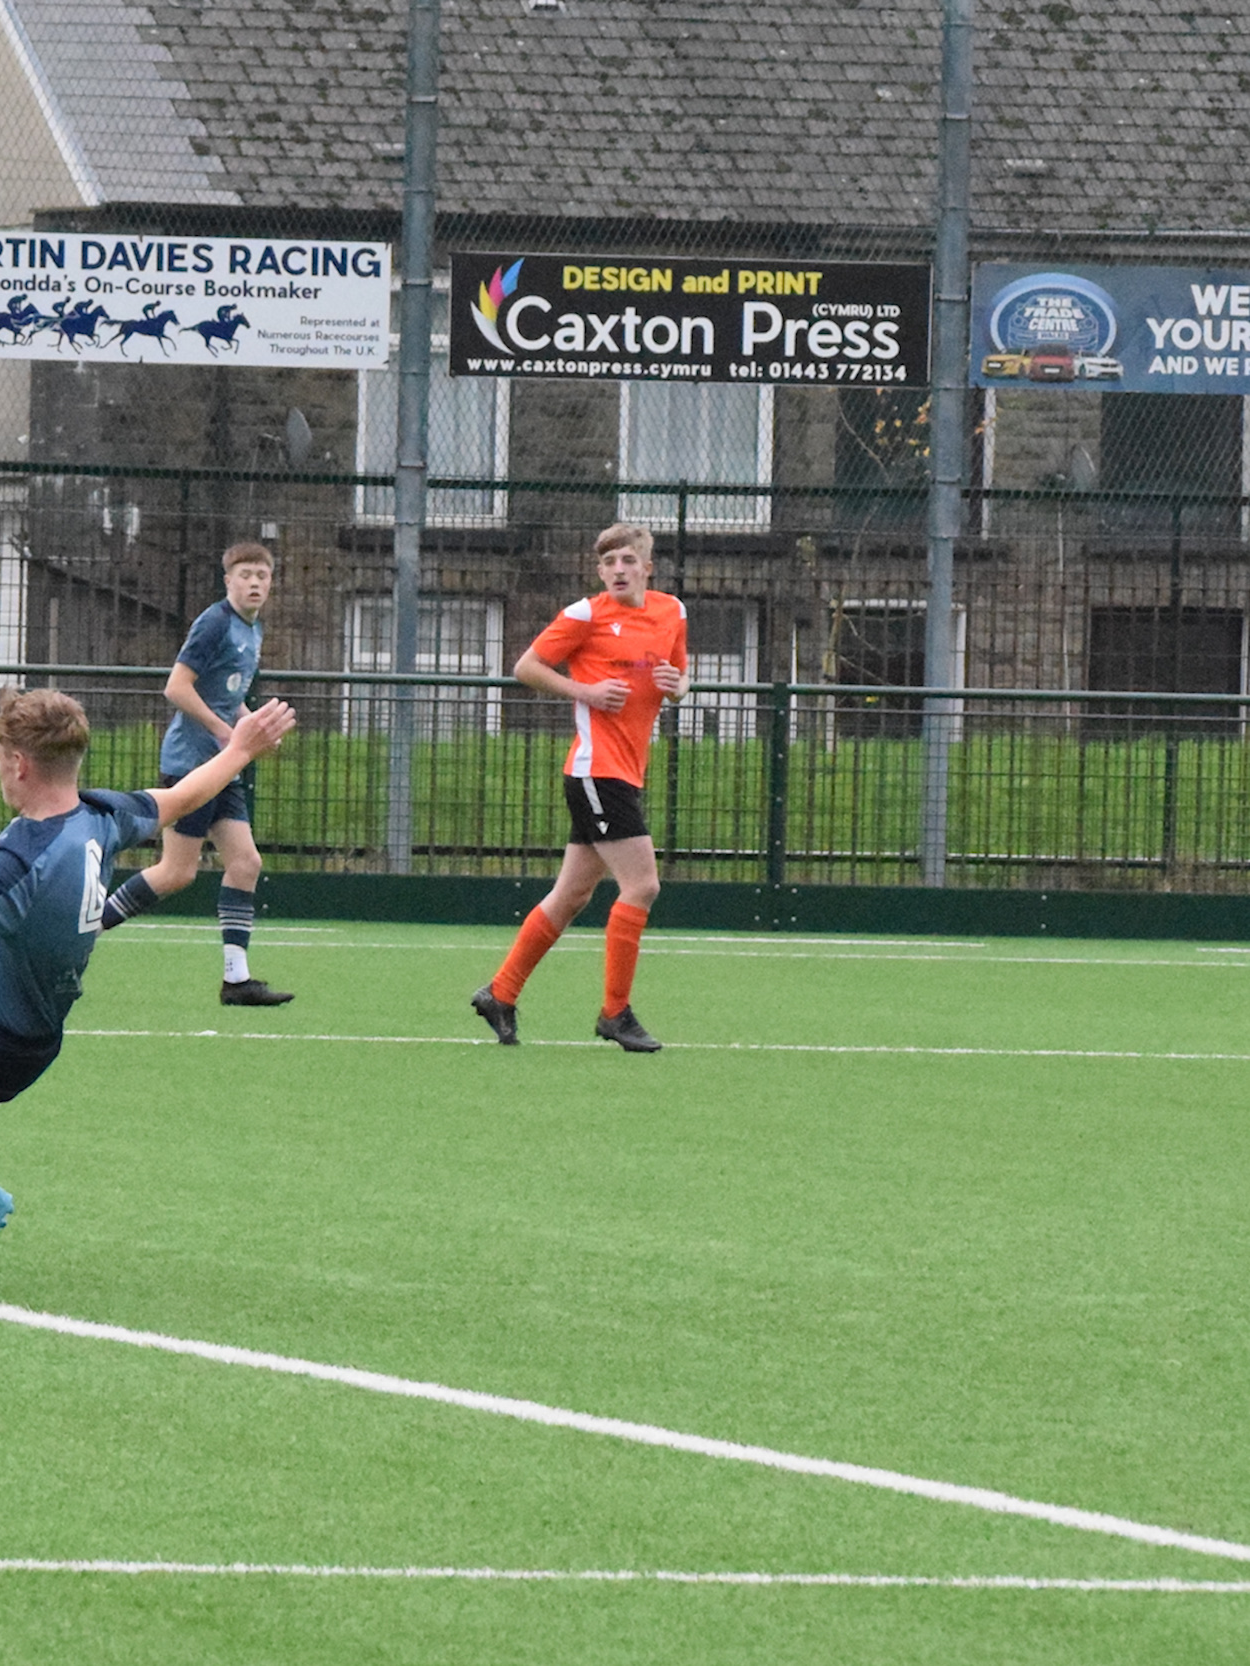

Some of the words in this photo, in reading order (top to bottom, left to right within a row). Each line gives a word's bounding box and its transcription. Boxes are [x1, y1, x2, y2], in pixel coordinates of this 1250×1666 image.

[81, 240, 213, 273] DAVIES
[230, 245, 381, 278] RACING
[84, 276, 196, 296] On-Course
[204, 280, 322, 299] Bookmaker
[563, 265, 672, 292] DESIGN
[682, 269, 730, 294] and
[738, 270, 823, 296] PRINT
[1036, 297, 1072, 307] THE
[1190, 284, 1250, 316] WE
[812, 303, 874, 320] (CYMRU)
[877, 305, 900, 318] LTD
[1023, 307, 1085, 319] TRADE
[300, 316, 366, 328] Represented
[370, 319, 380, 328] at
[506, 295, 714, 355] Caxton
[742, 301, 900, 359] Press
[1028, 317, 1080, 332] CENTRE
[257, 329, 311, 340] Numerous
[315, 331, 380, 342] Racecourses
[1146, 318, 1250, 351] YOUR
[270, 343, 329, 356] Throughout
[334, 345, 351, 355] The
[467, 358, 712, 377] www.caxtonpress.cymru
[729, 361, 764, 377] tel:
[769, 362, 829, 378] 01443
[836, 364, 907, 381] 772134
[1148, 355, 1199, 375] AND
[1203, 356, 1239, 376] WE
